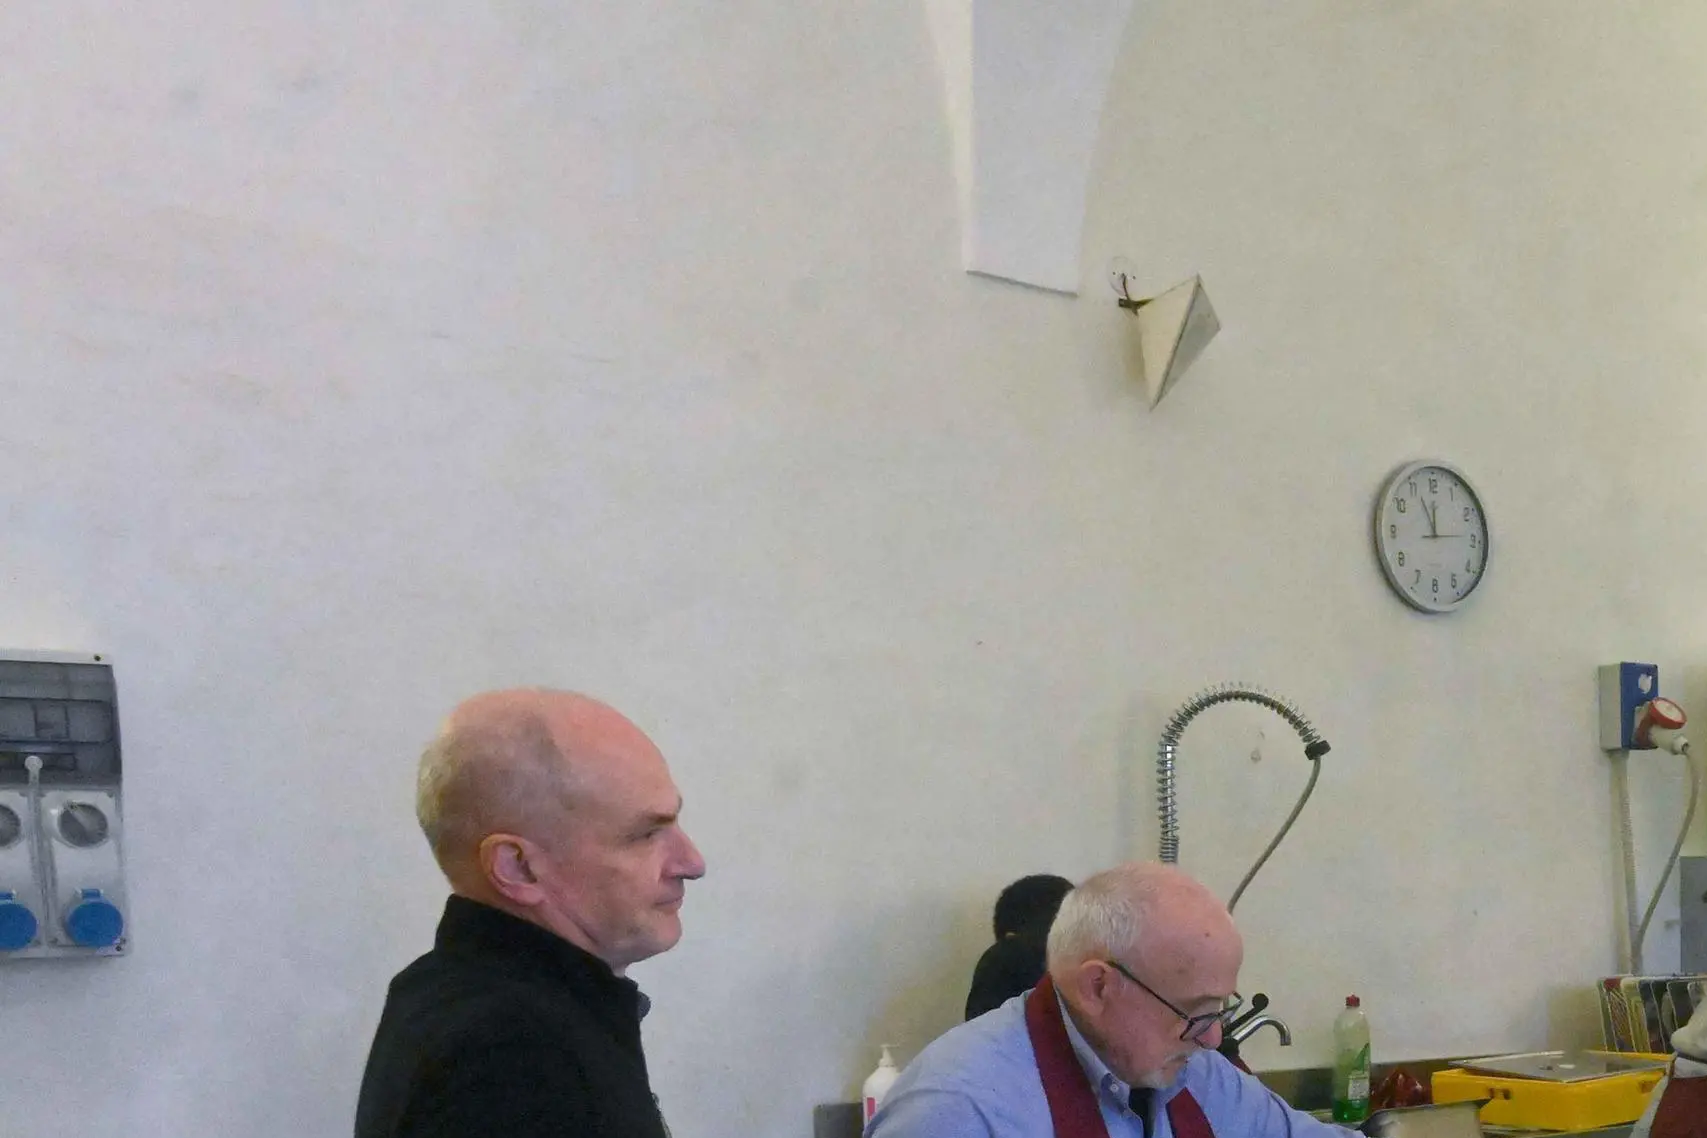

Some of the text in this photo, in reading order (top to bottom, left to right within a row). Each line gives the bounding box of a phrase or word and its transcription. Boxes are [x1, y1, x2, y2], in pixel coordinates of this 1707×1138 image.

[1409, 481, 1418, 497] 11
[1428, 478, 1438, 494] 12
[1393, 497, 1406, 513] 10
[1463, 507, 1470, 522] 2
[1390, 524, 1397, 539] 9
[1469, 534, 1476, 549] 3
[1397, 551, 1405, 567] 8
[1465, 559, 1471, 573] 4
[1414, 569, 1422, 584] 7
